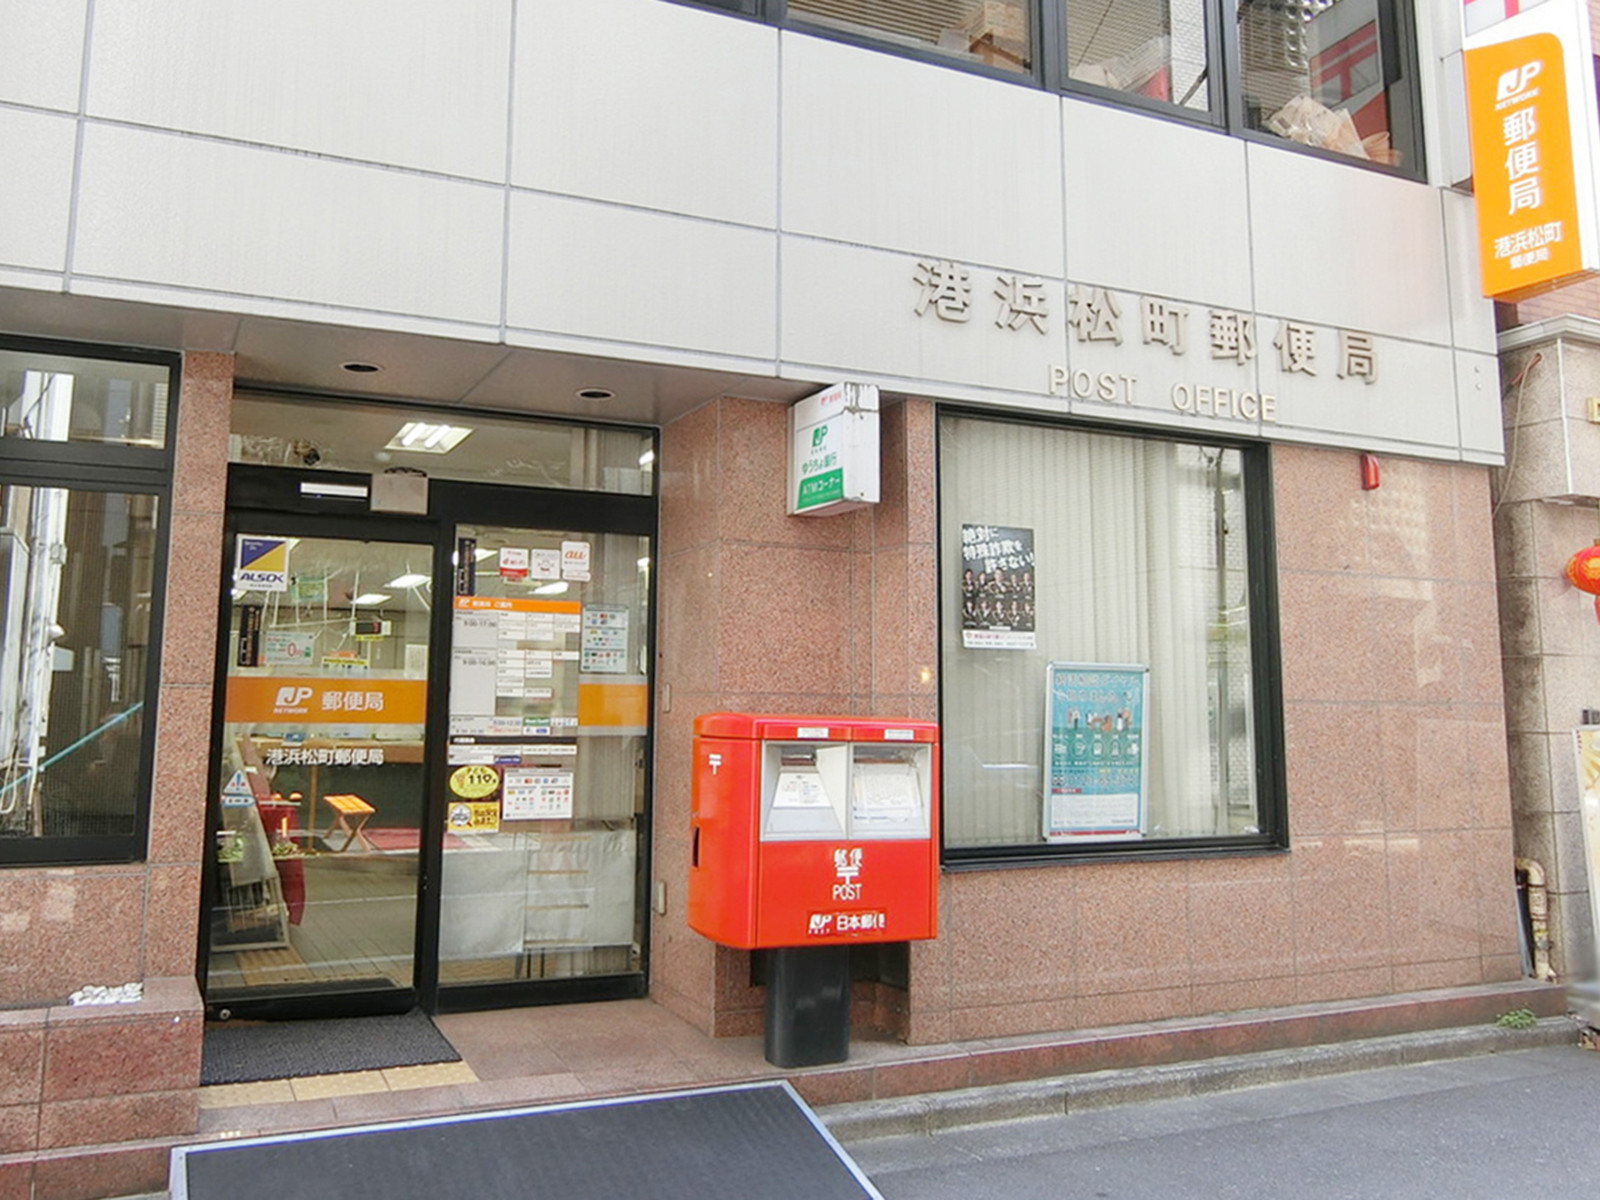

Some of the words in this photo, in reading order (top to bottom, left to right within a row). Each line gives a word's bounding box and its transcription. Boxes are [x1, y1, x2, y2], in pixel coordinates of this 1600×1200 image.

[1503, 106, 1542, 215] 郵便局
[1494, 221, 1563, 259] 港浜松町
[913, 260, 1381, 385] 港浜松町郵便局
[1048, 363, 1138, 405] POST
[1171, 383, 1277, 423] OFFICE
[564, 550, 586, 560] au
[240, 572, 284, 583] ALSOK
[321, 690, 384, 712] 郵便局
[265, 748, 385, 766] 港浜松町郵便局
[834, 848, 863, 869] 郵便
[832, 882, 863, 901] POST
